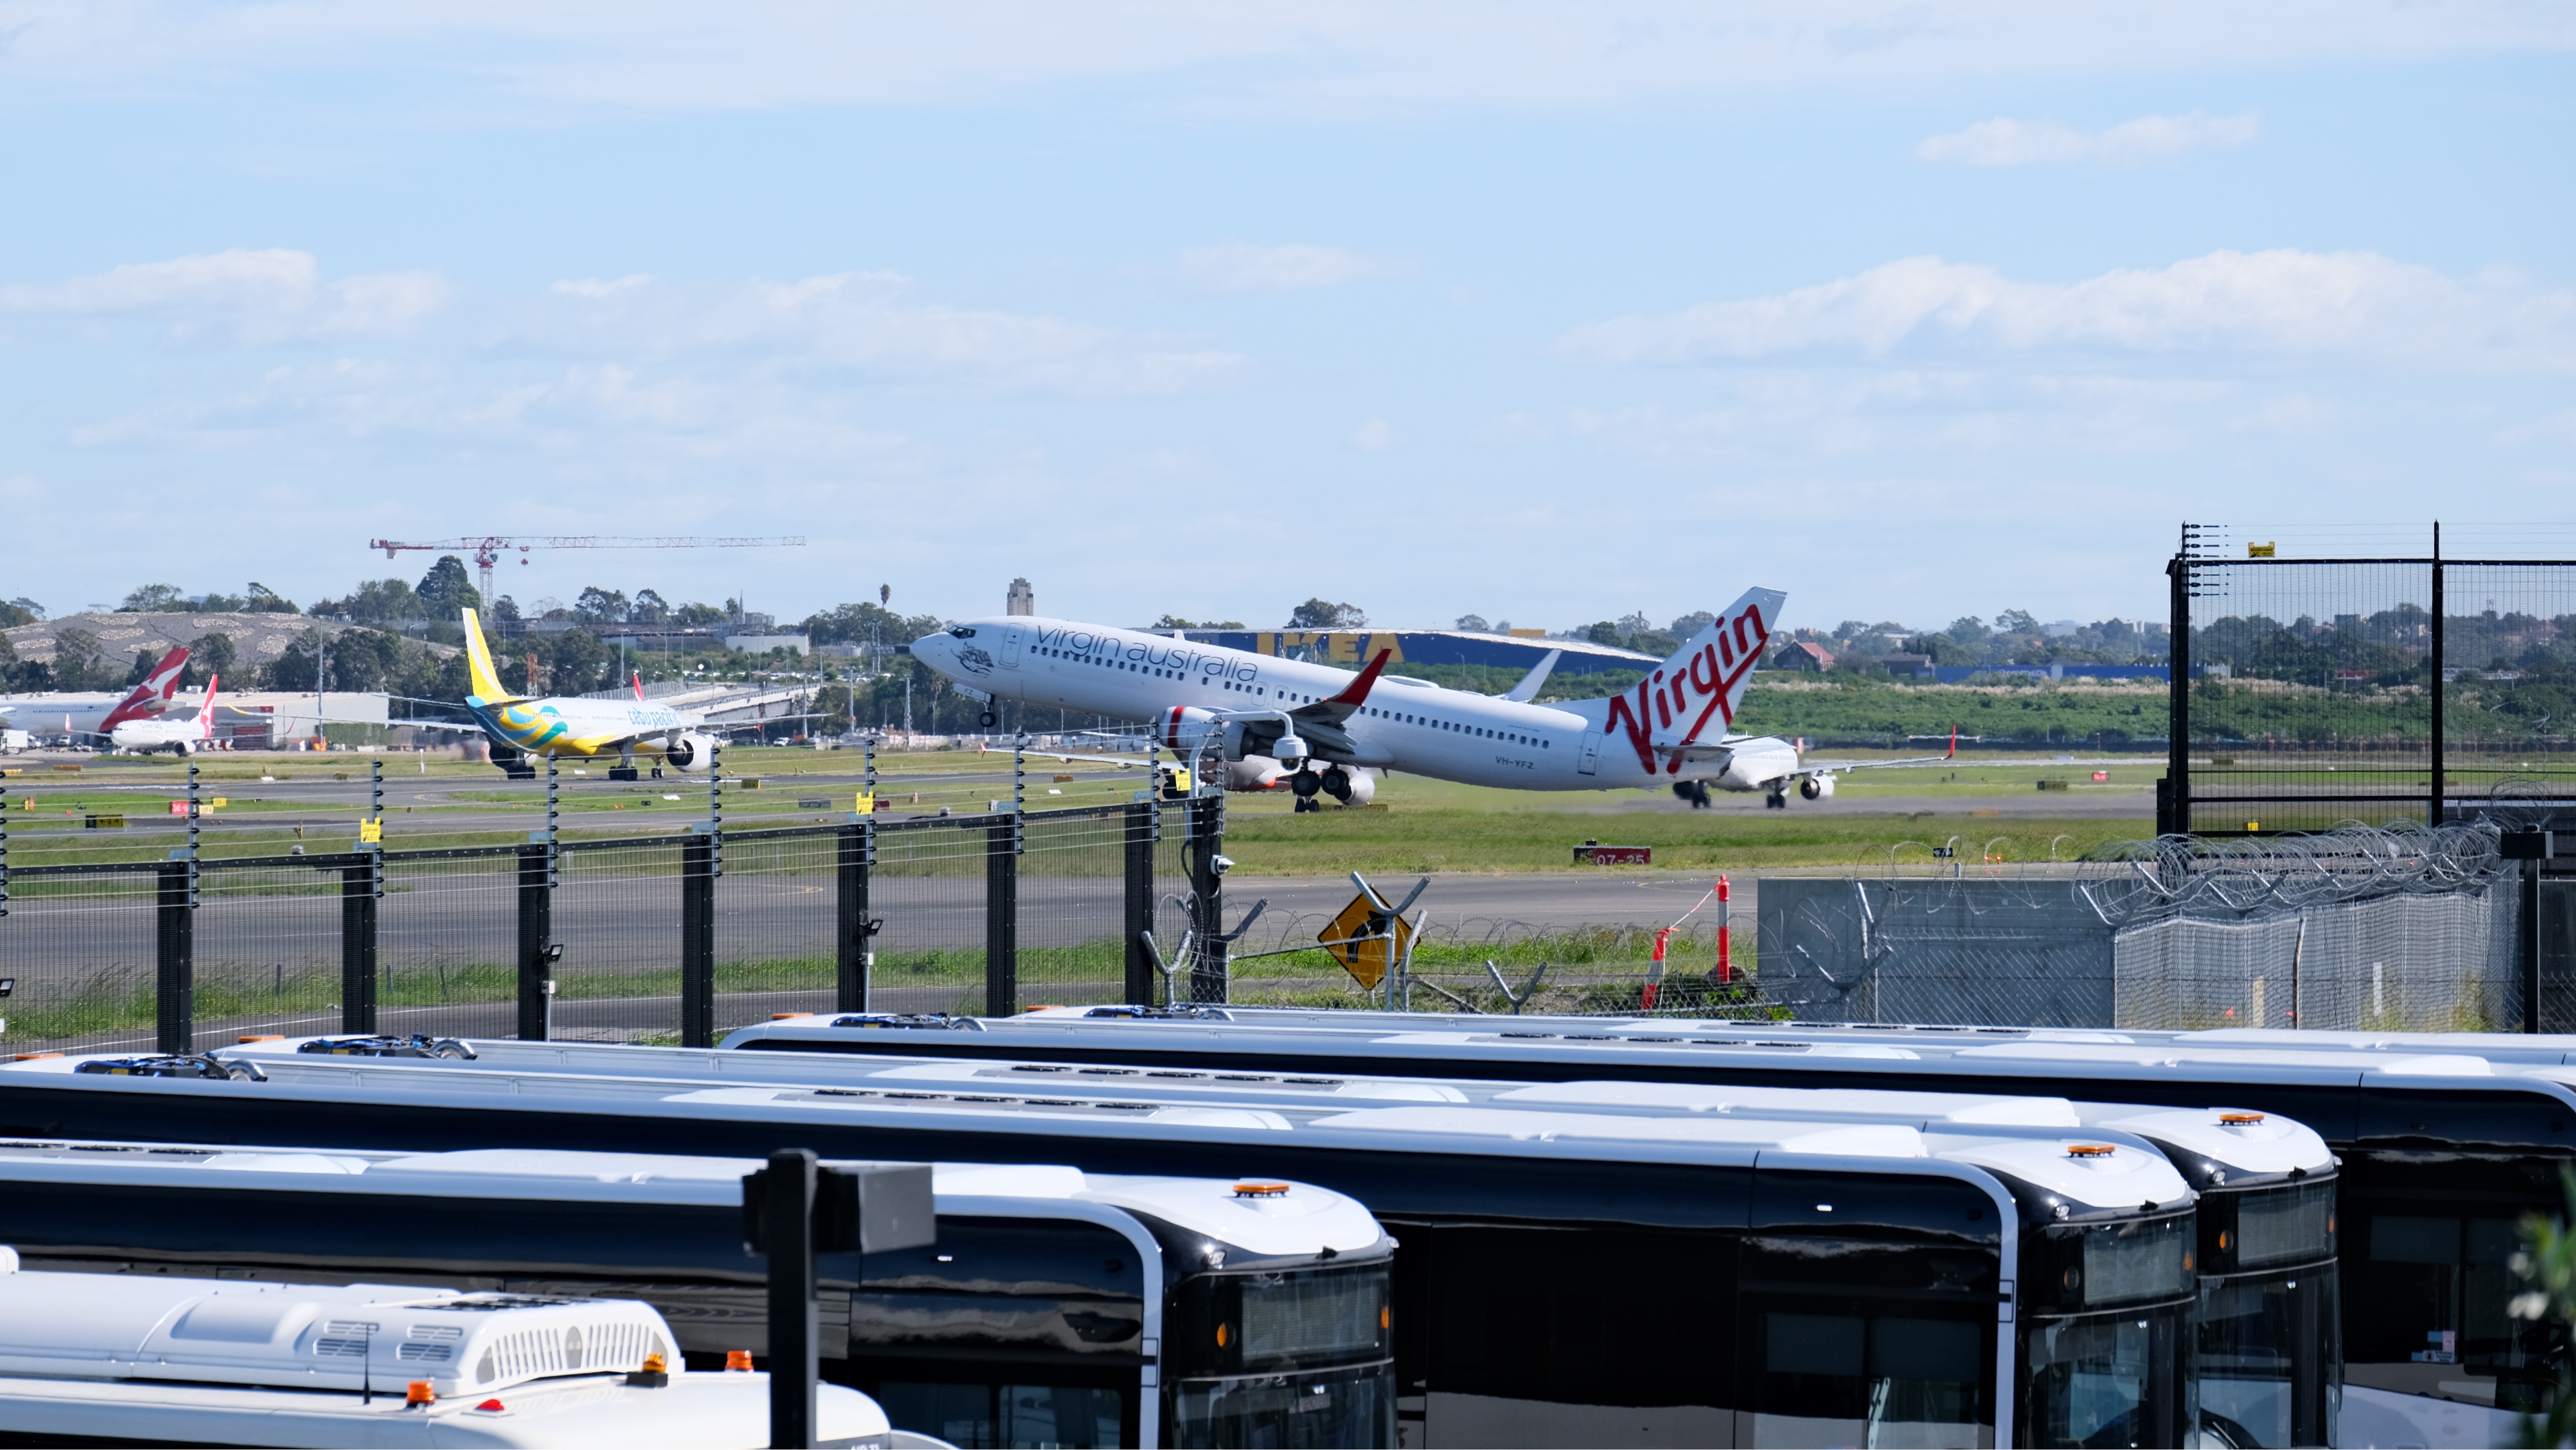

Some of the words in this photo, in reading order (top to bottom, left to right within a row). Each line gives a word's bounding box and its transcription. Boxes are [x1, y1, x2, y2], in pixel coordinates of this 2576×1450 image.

[1038, 625, 1121, 657] virgin
[1127, 642, 1258, 682] australia
[1605, 603, 1769, 775] Virgin
[628, 706, 652, 725] cebu
[1496, 756, 1534, 770] VH-YFZ
[1597, 855, 1645, 866] 07-25
